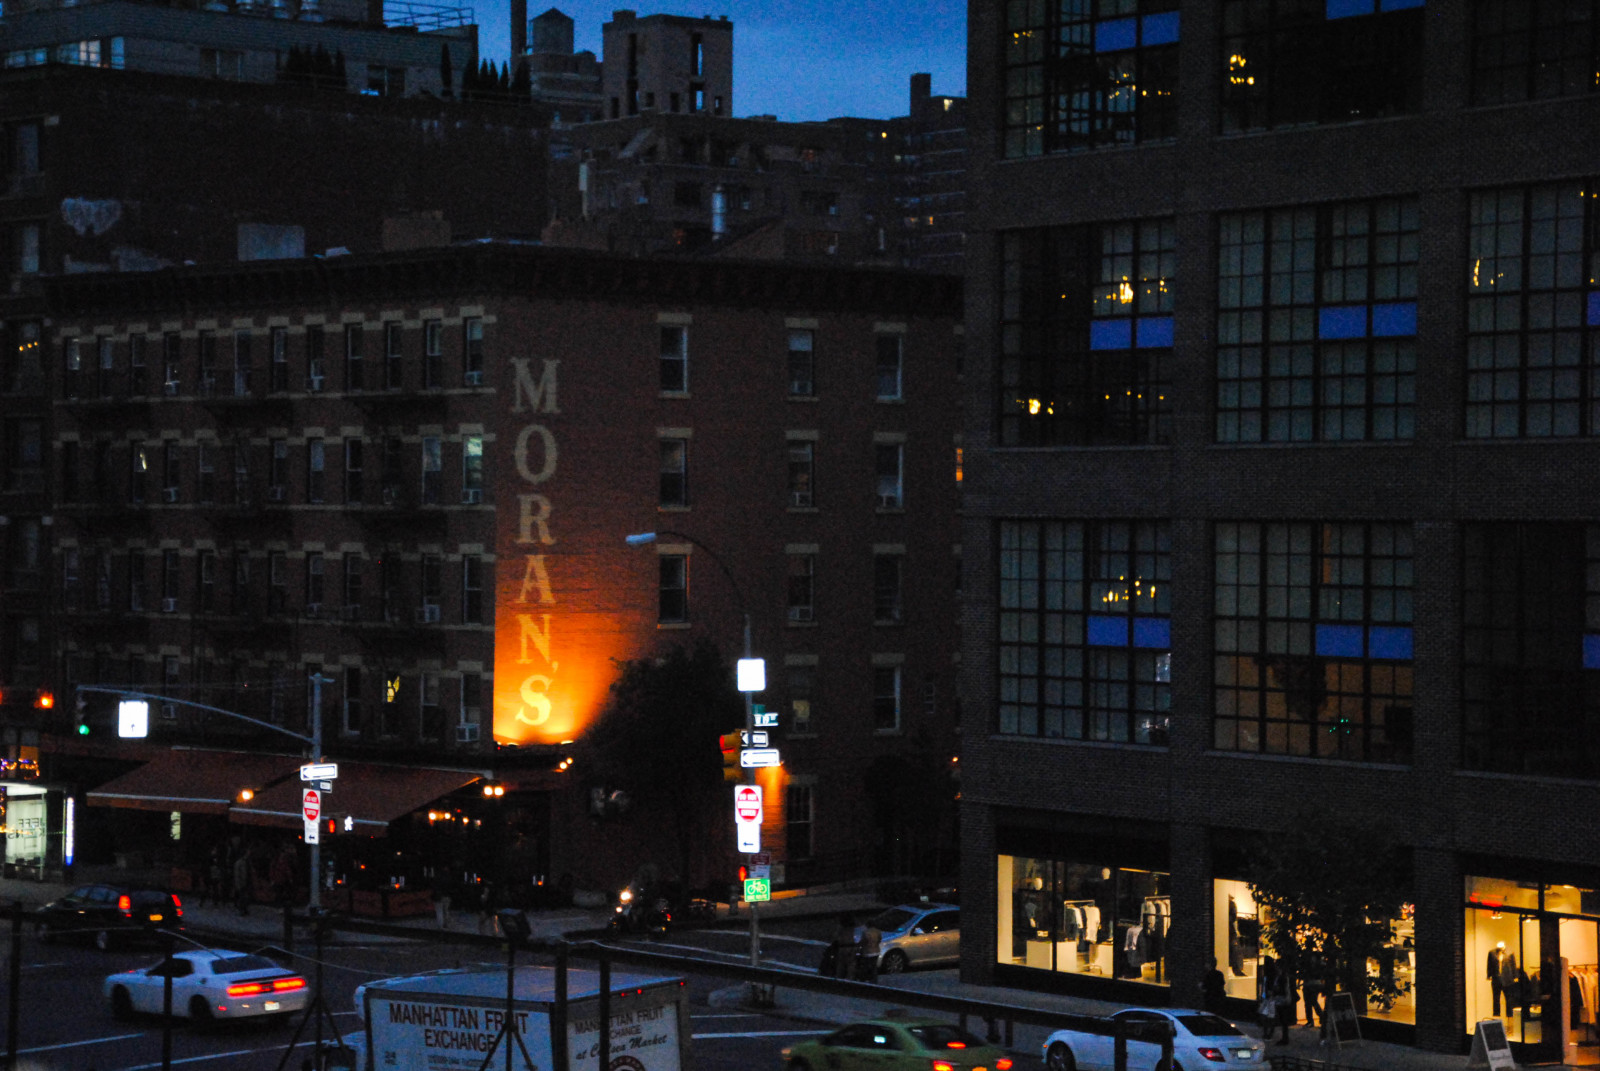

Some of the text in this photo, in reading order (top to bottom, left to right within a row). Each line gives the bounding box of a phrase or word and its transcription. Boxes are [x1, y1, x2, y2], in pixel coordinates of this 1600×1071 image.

[510, 356, 562, 726] MORAN'S
[389, 1003, 528, 1033] MANHATTAN FRIT
[637, 1006, 664, 1021] FRUIT
[425, 1029, 495, 1052] EXCHANGE
[629, 1034, 668, 1049] Market
